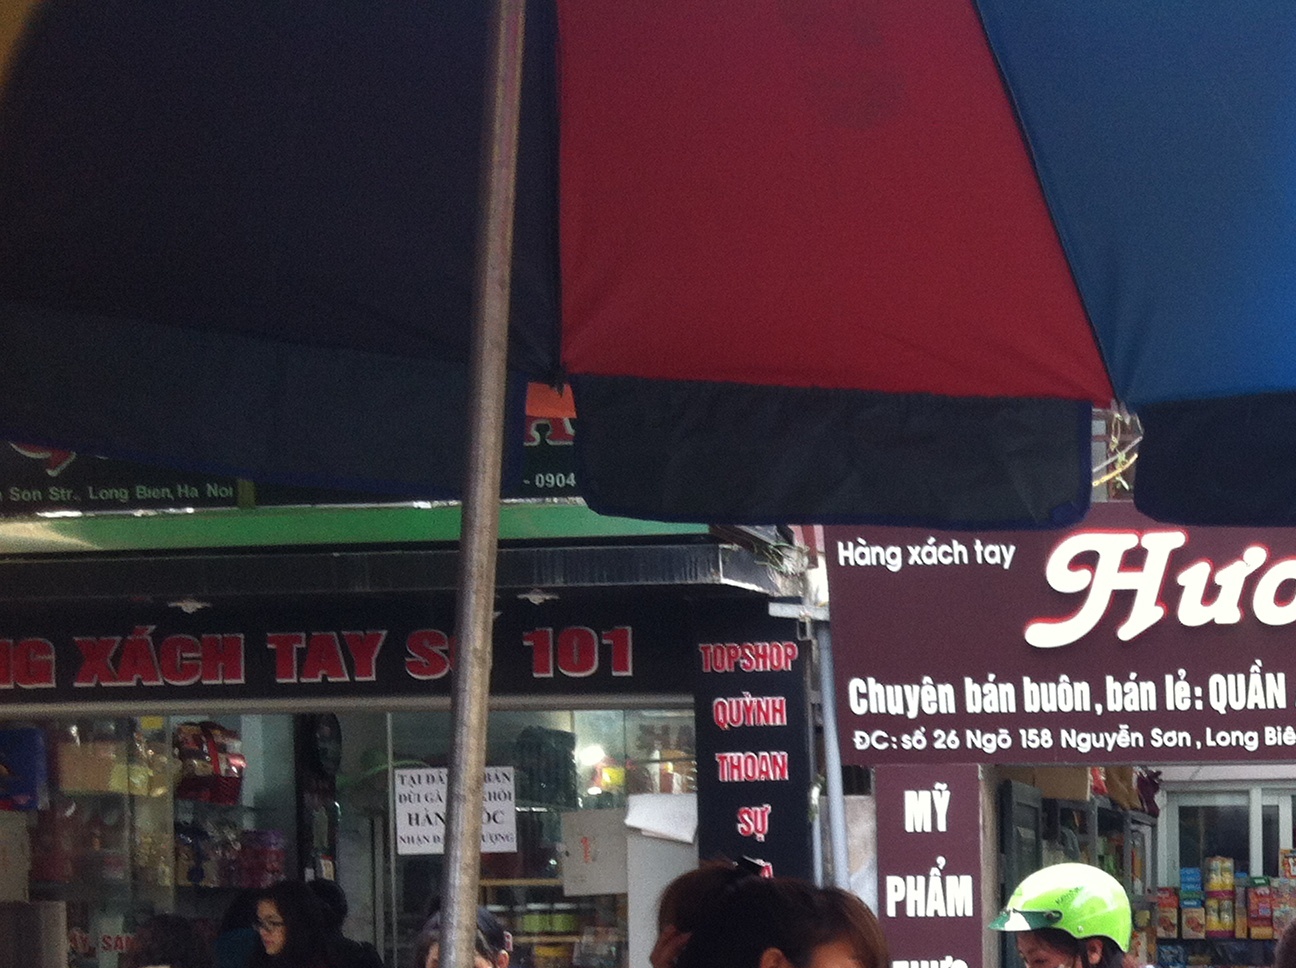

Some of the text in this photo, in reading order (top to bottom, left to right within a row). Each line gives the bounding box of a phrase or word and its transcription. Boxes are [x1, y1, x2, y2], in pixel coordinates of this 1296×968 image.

[88, 486, 129, 503] Long
[535, 473, 577, 488] 0904
[837, 536, 1016, 573] Hàng xách tay
[73, 625, 246, 687] XÁCH
[266, 629, 388, 684] TAY
[405, 628, 461, 681] S
[522, 625, 633, 678] 101
[700, 641, 799, 673] TOPSHOP
[848, 675, 956, 719] Chuyên
[963, 672, 1016, 713] bán
[1105, 670, 1156, 711] bán
[1208, 658, 1287, 715] QUẦN
[712, 691, 789, 731] QUỲNH
[932, 729, 961, 750] 26
[965, 728, 1013, 754] Ngõ
[1018, 728, 1054, 749] 158
[1060, 723, 1144, 754] Nguyễn
[1205, 727, 1259, 752] Long
[736, 804, 772, 842] SỰ
[903, 781, 951, 833] MỸ
[885, 855, 974, 918] PHẨM
